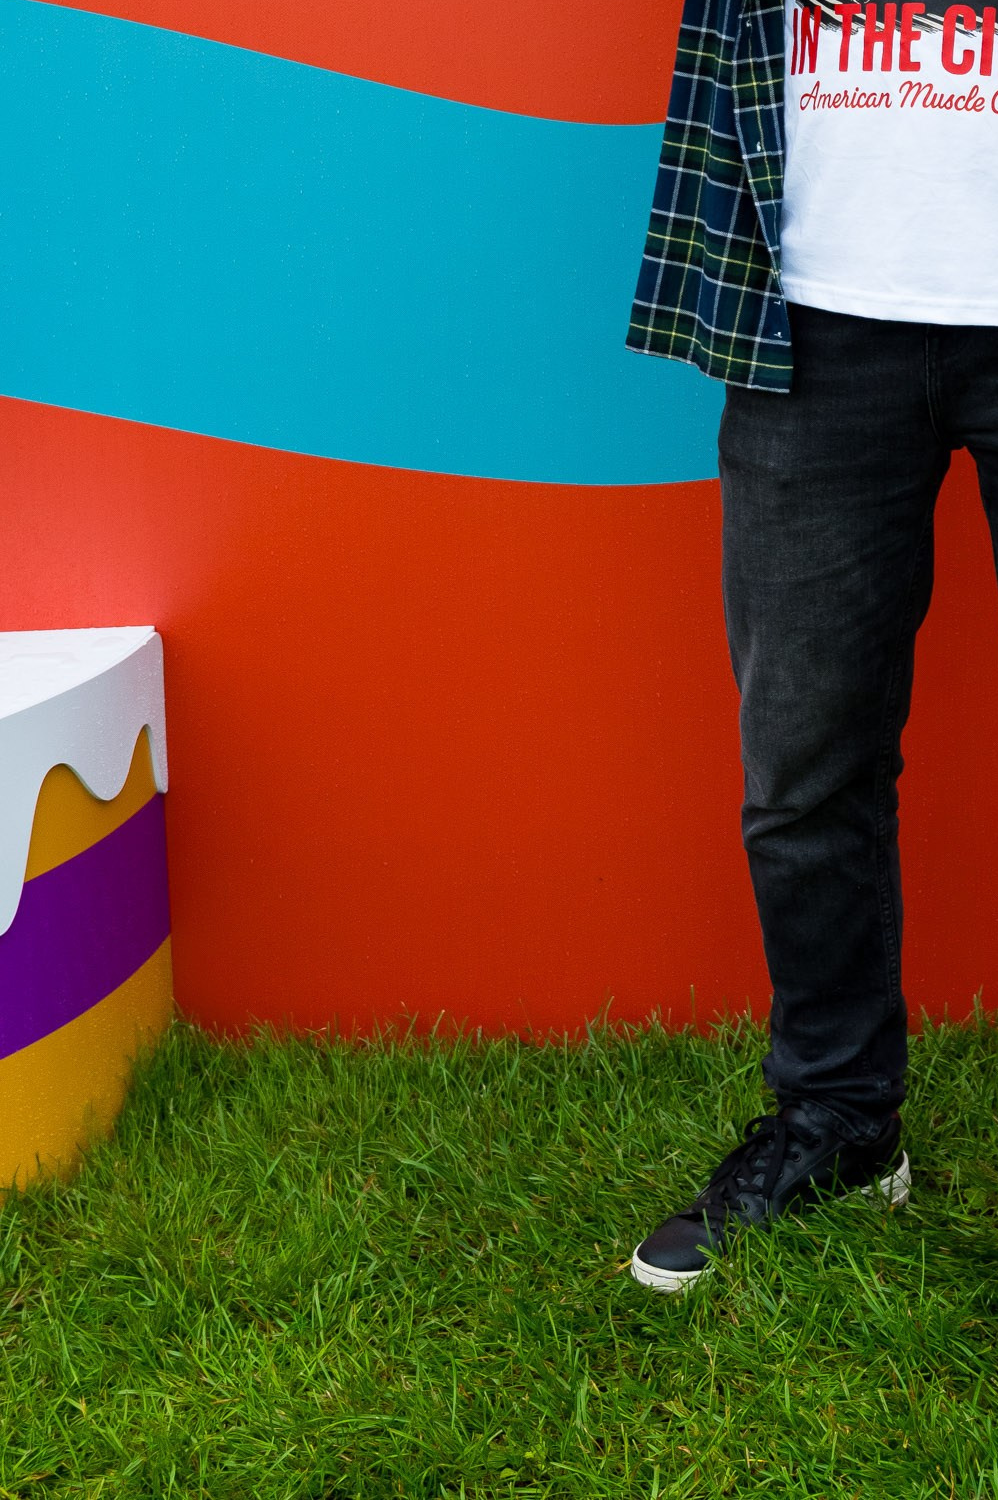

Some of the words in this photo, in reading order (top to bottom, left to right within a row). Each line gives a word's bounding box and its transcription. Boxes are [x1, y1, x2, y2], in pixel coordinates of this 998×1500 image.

[790, 4, 822, 76] IN
[834, 2, 926, 72] THE
[799, 80, 892, 112] American
[898, 80, 986, 113] Muscle
